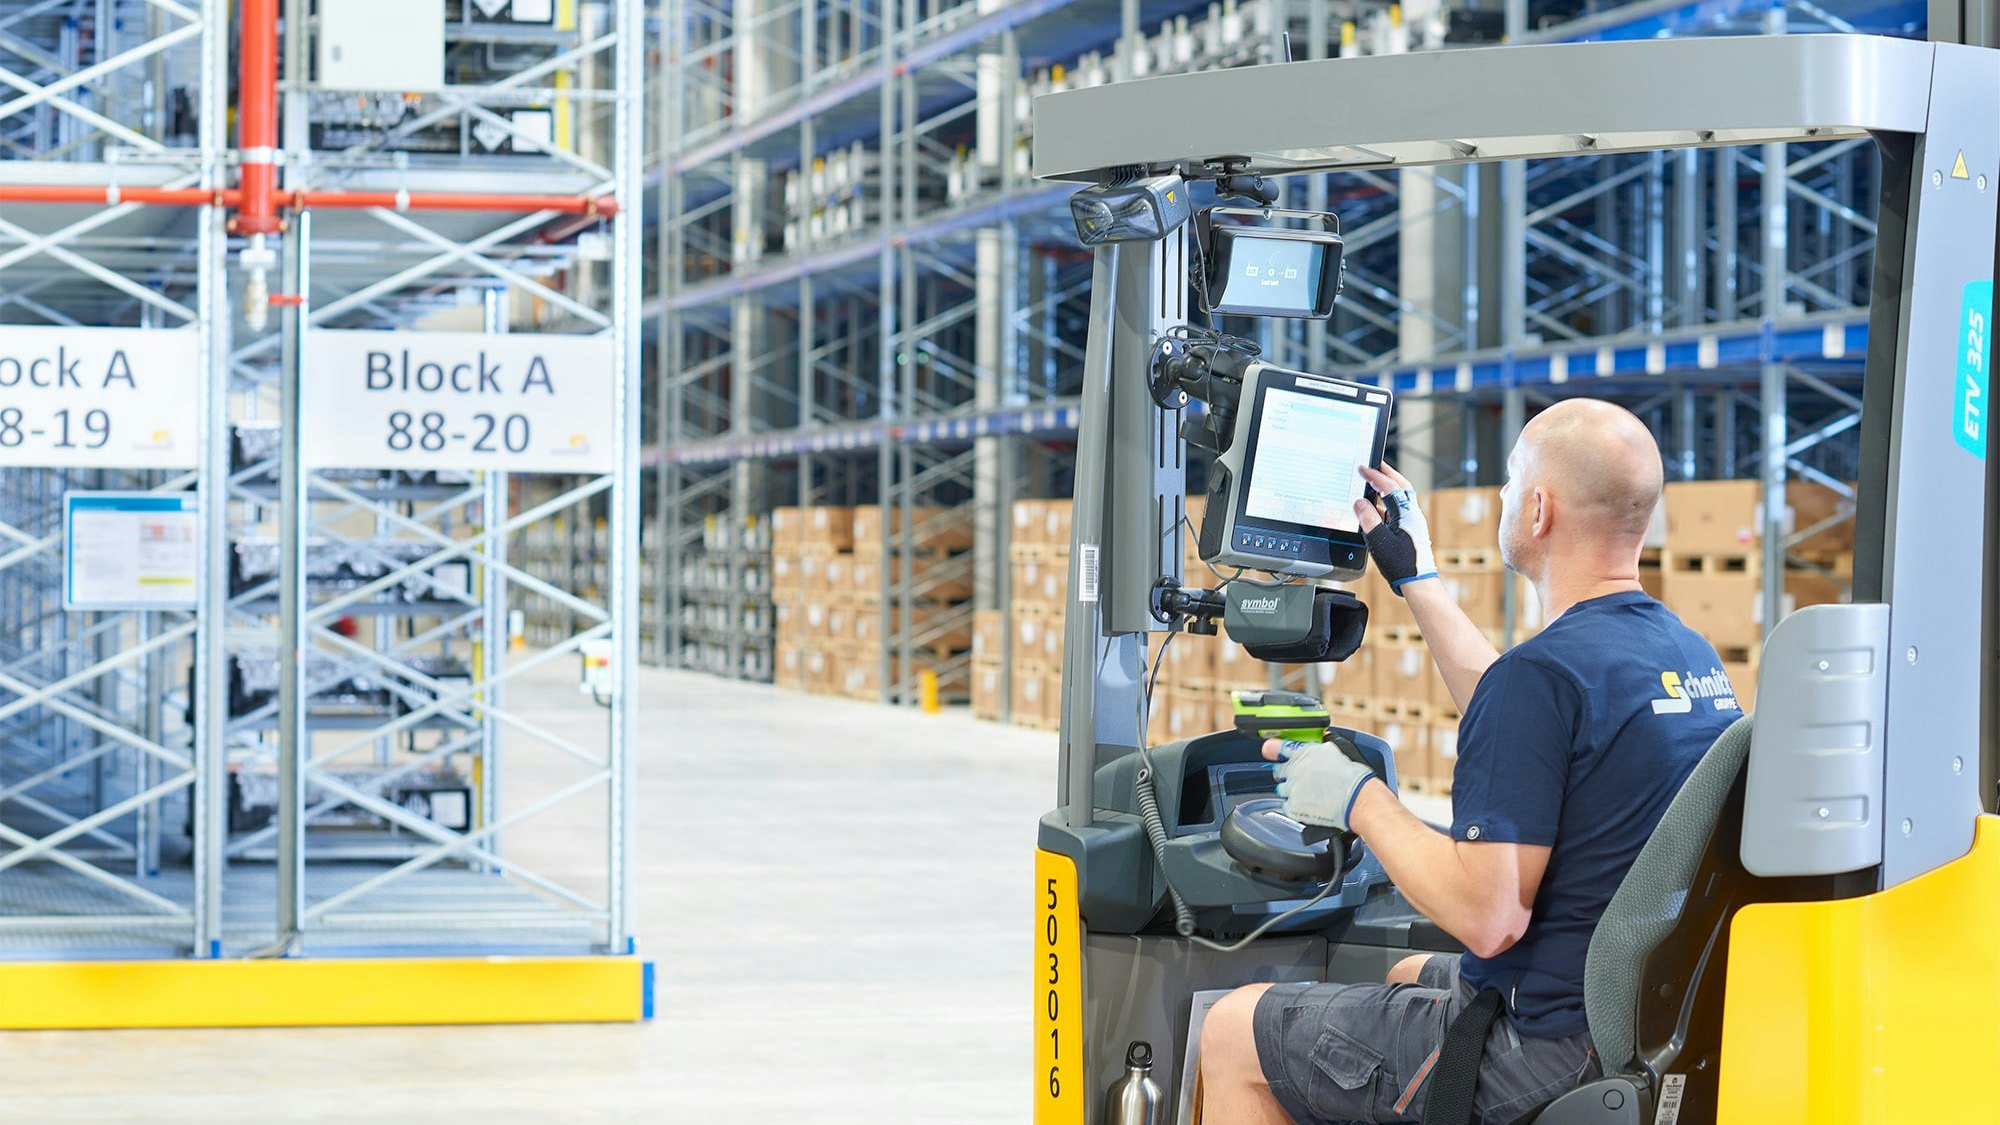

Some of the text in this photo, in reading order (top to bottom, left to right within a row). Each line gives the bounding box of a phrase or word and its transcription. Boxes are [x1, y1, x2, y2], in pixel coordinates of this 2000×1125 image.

[102, 350, 136, 389] A
[365, 350, 555, 394] Block A
[1964, 308, 1984, 442] ETV 325
[0, 407, 111, 449] 8-19
[386, 411, 530, 453] 88-20
[1240, 597, 1279, 611] symbol
[1046, 878, 1061, 1098] 503016
